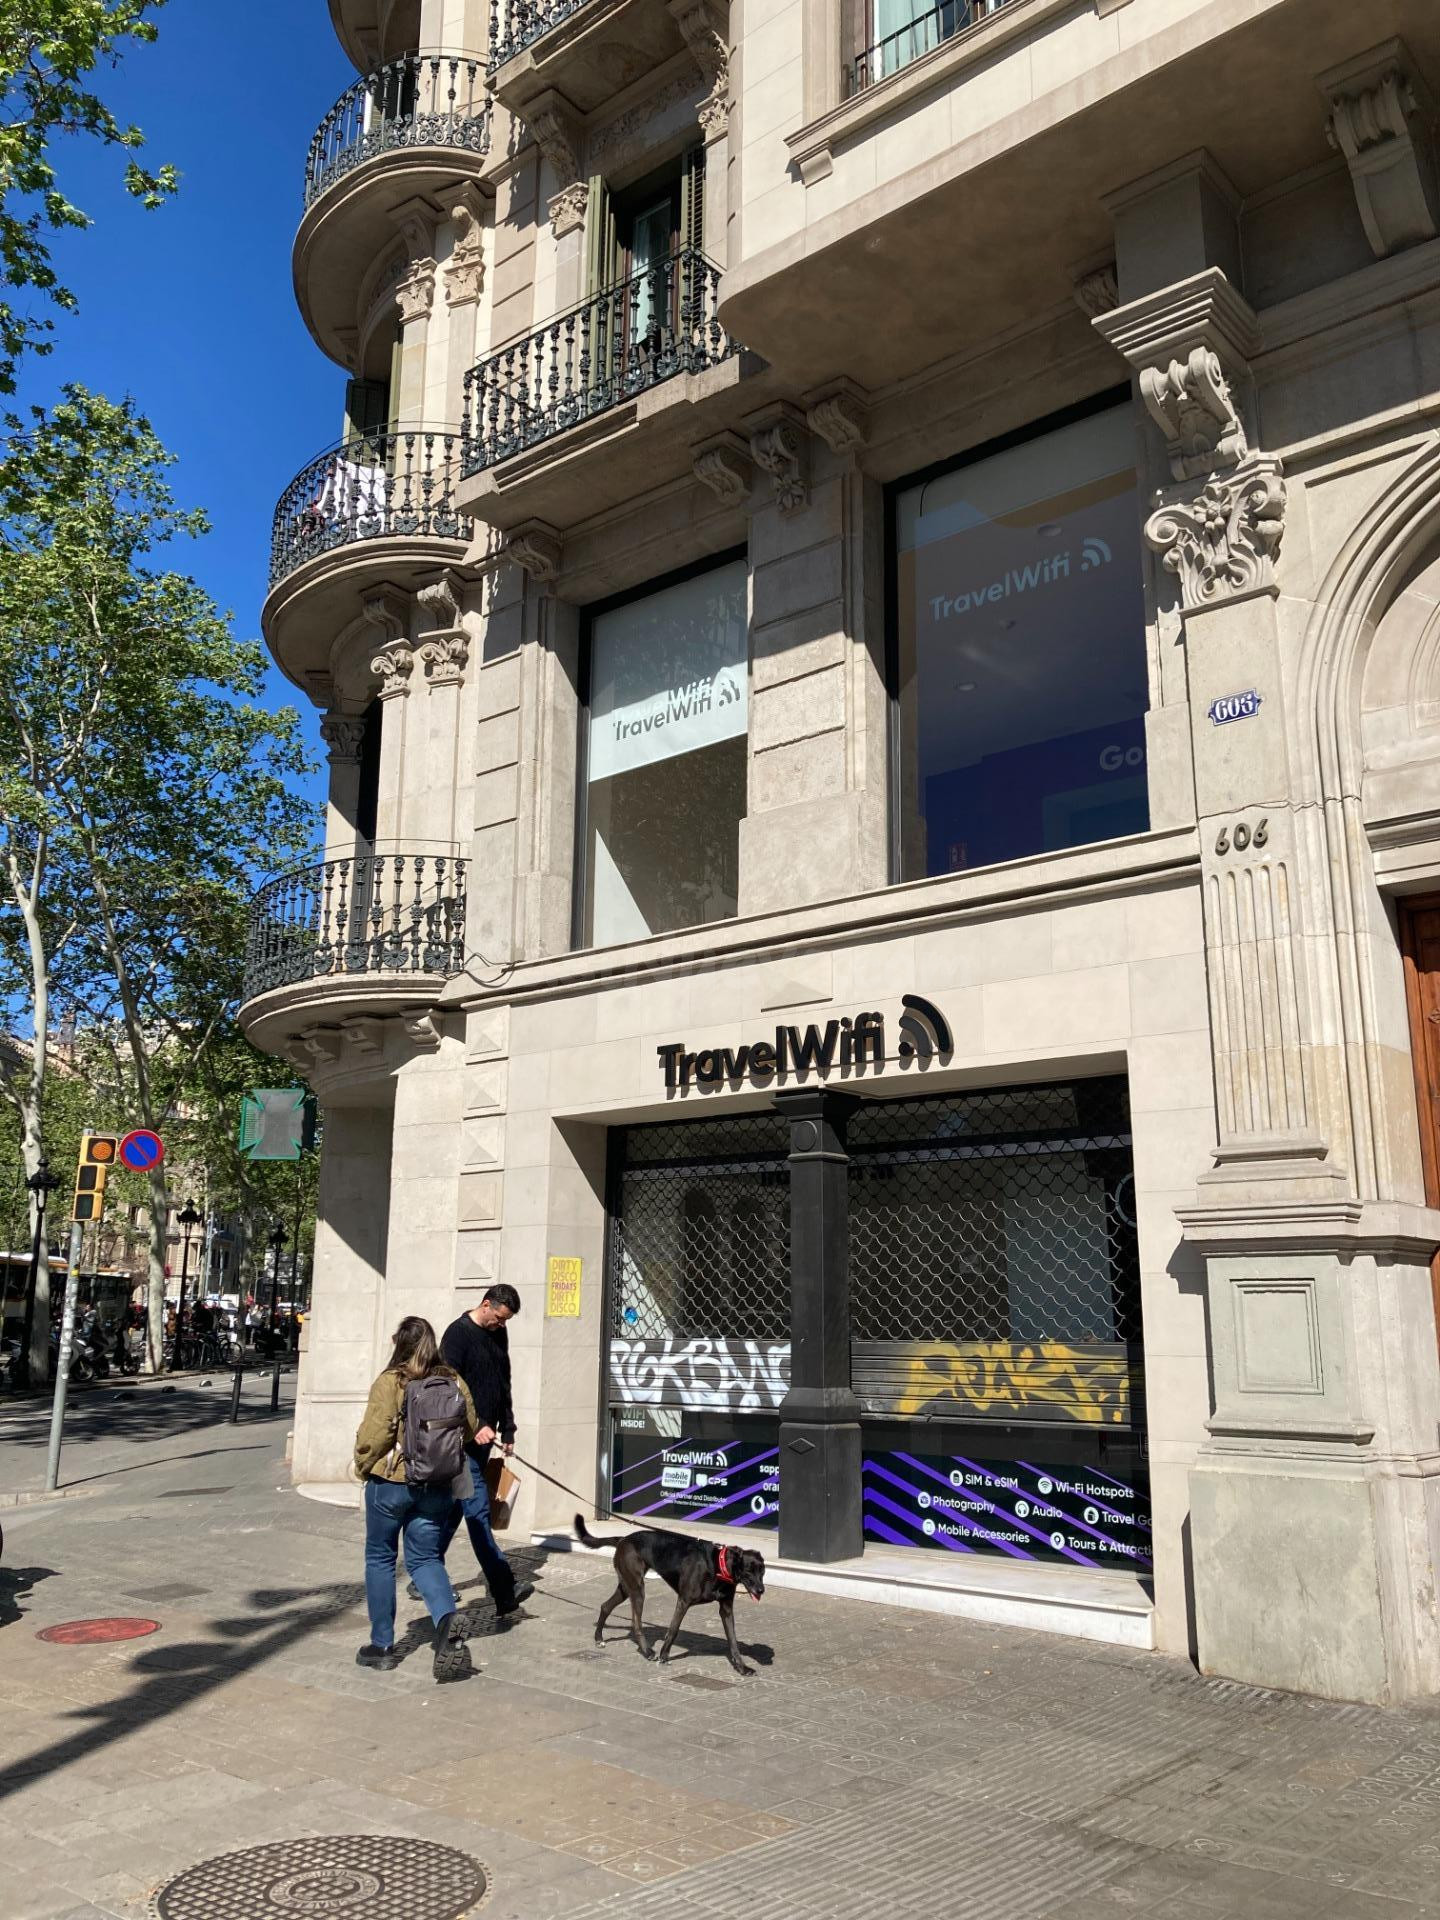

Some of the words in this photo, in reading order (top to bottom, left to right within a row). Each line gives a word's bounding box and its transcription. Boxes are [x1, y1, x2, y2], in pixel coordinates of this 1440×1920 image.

[929, 552, 1071, 621] TravelWifi
[1215, 818, 1268, 857] 606
[657, 1011, 884, 1088] TravelWifi
[552, 1259, 578, 1270] DIRTY
[551, 1271, 577, 1281] DISCO
[551, 1291, 577, 1301] DIRTY
[551, 1302, 577, 1313] DISCO
[620, 1419, 645, 1429] INSIDE!
[661, 1449, 714, 1466] TravelWifi
[708, 1477, 728, 1486] CPS
[964, 1474, 983, 1487] SIM
[985, 1476, 993, 1487] &
[994, 1476, 1018, 1489] eSIM
[1055, 1481, 1084, 1494] Wi-Fi
[1086, 1484, 1135, 1499] Hotspots
[932, 1495, 995, 1514] Photography
[1032, 1505, 1063, 1518] Audio
[1102, 1511, 1135, 1525] Travel
[938, 1523, 970, 1537] Mobile
[972, 1527, 1030, 1544] Accessories
[1068, 1536, 1096, 1550] Tours
[1099, 1540, 1107, 1552] &
